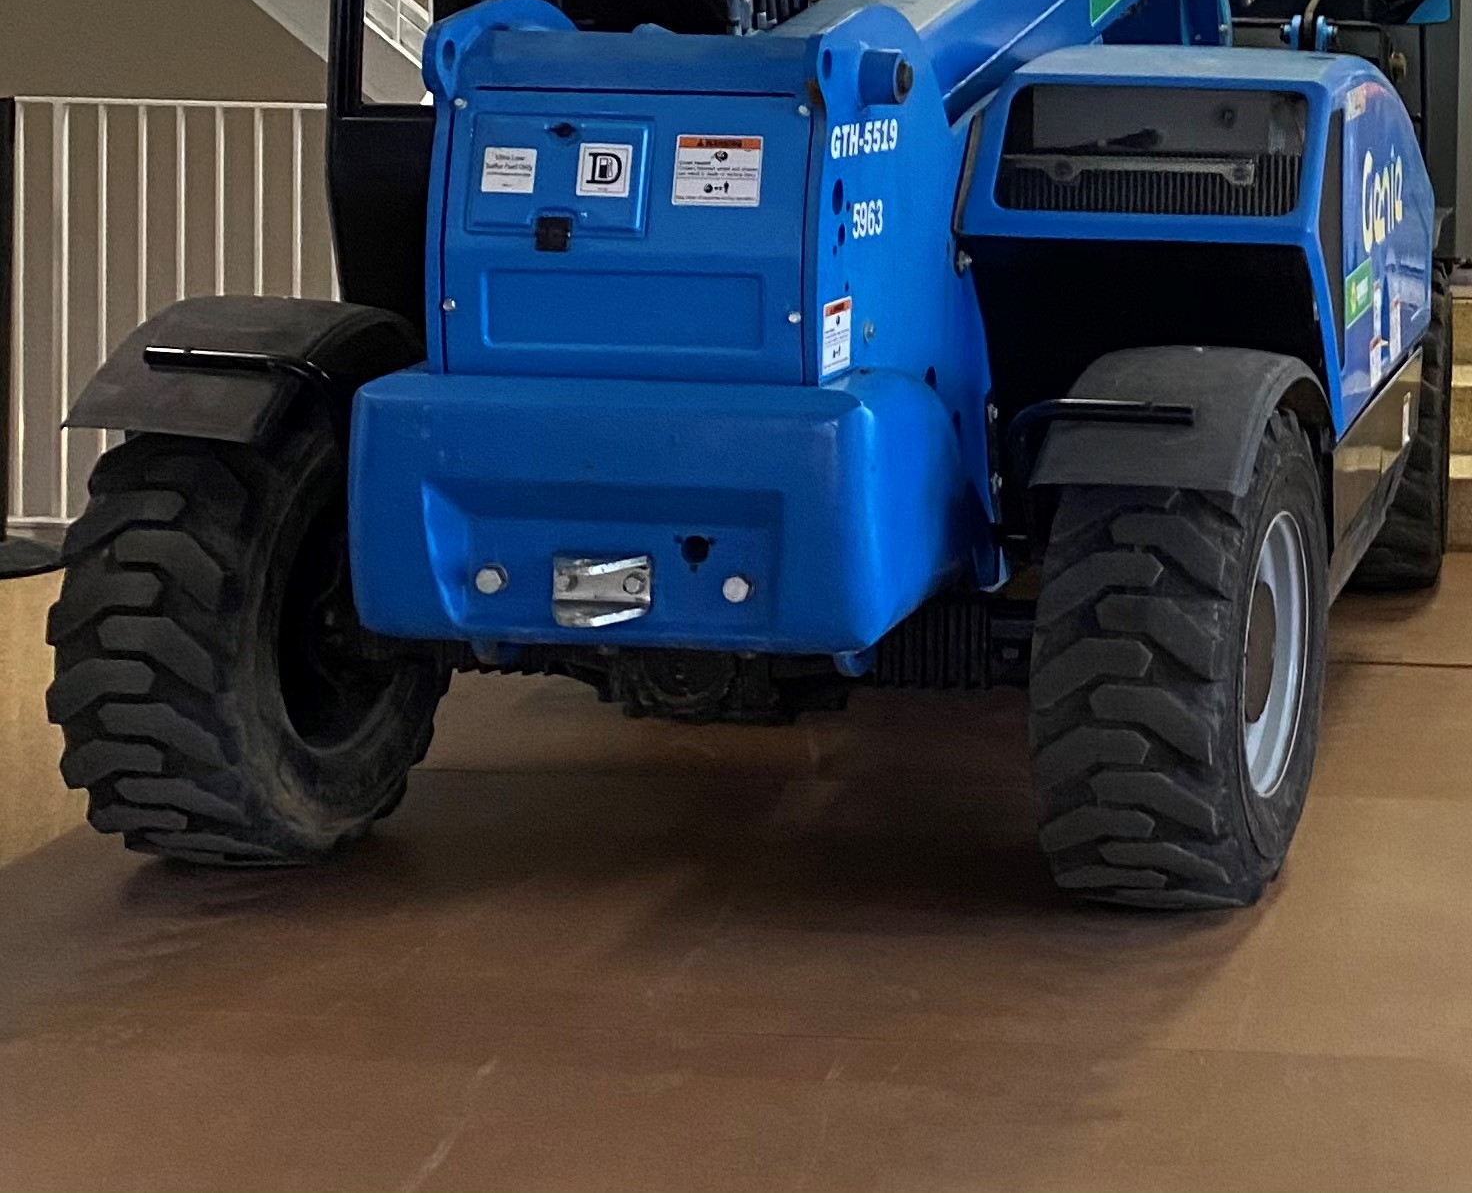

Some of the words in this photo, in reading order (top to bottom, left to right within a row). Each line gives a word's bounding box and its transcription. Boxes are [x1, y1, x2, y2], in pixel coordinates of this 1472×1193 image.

[831, 118, 898, 160] GTH-5519
[586, 152, 622, 185] D
[1362, 143, 1403, 254] Genie
[852, 199, 883, 240] 5963
